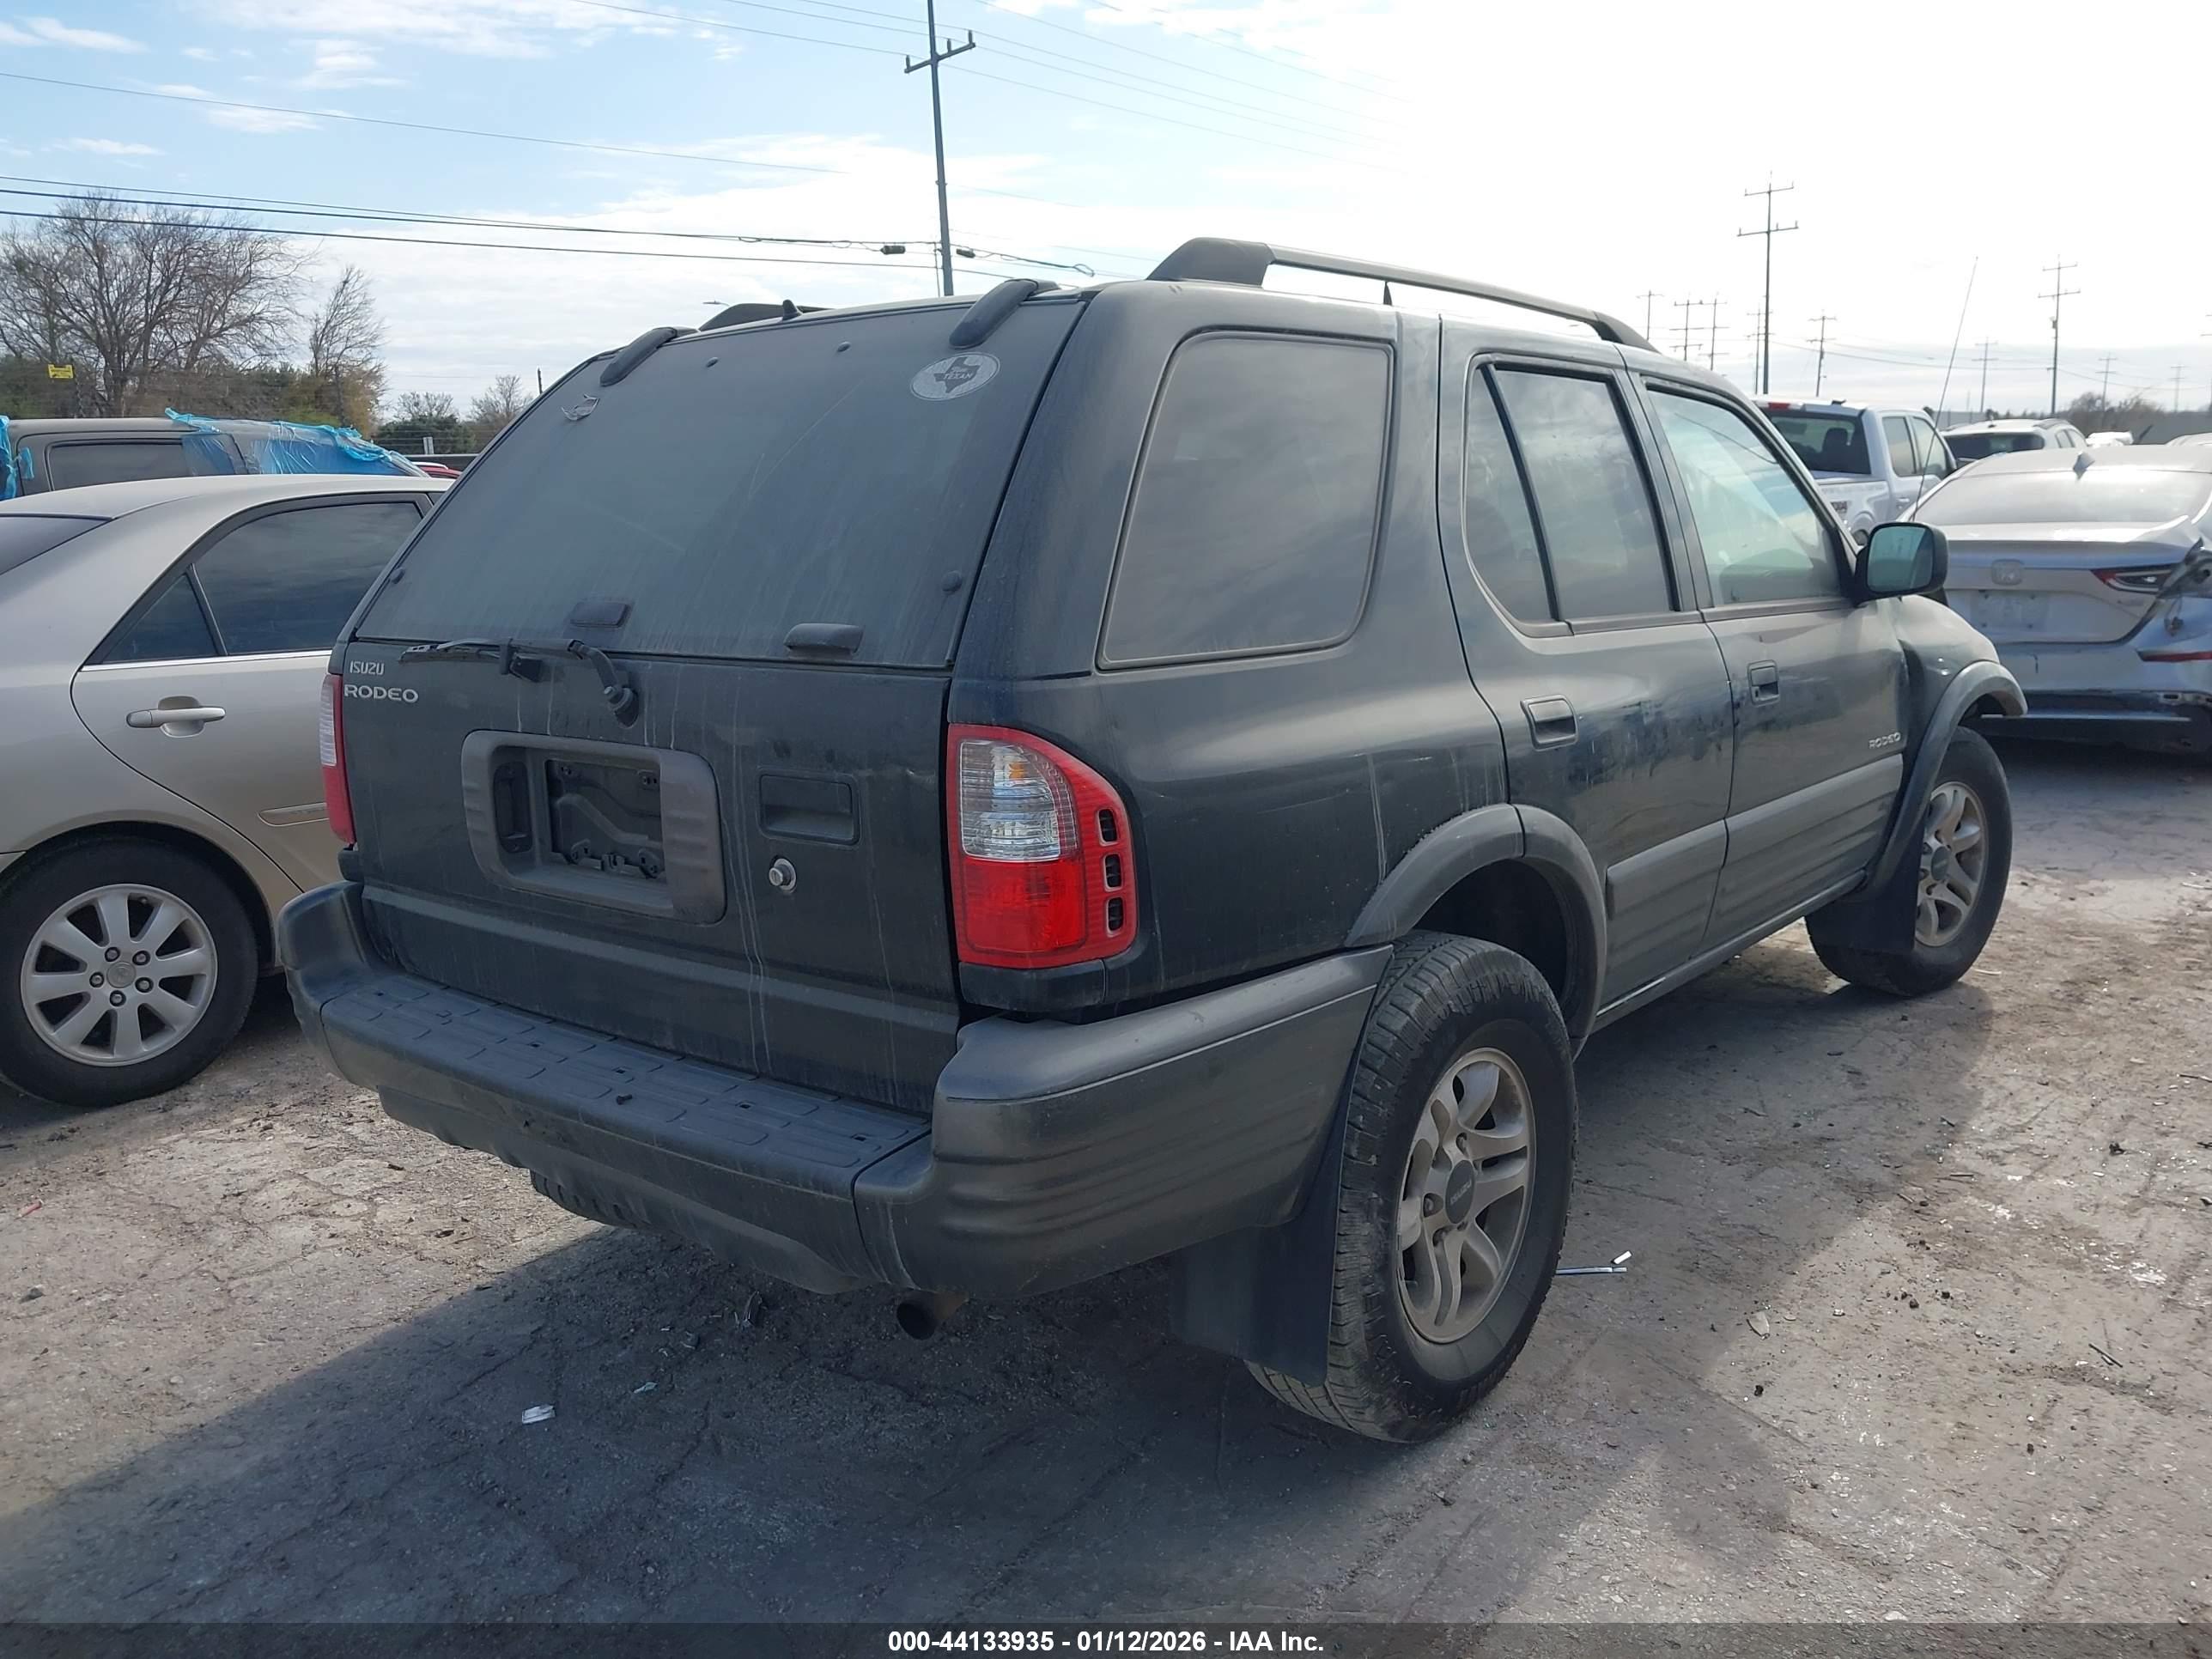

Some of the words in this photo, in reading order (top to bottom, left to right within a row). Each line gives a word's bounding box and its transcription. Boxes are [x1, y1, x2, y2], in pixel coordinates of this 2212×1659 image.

[349, 660, 385, 675] ISUZU
[343, 684, 419, 703] RODEO
[1869, 732, 1901, 750] RODEO
